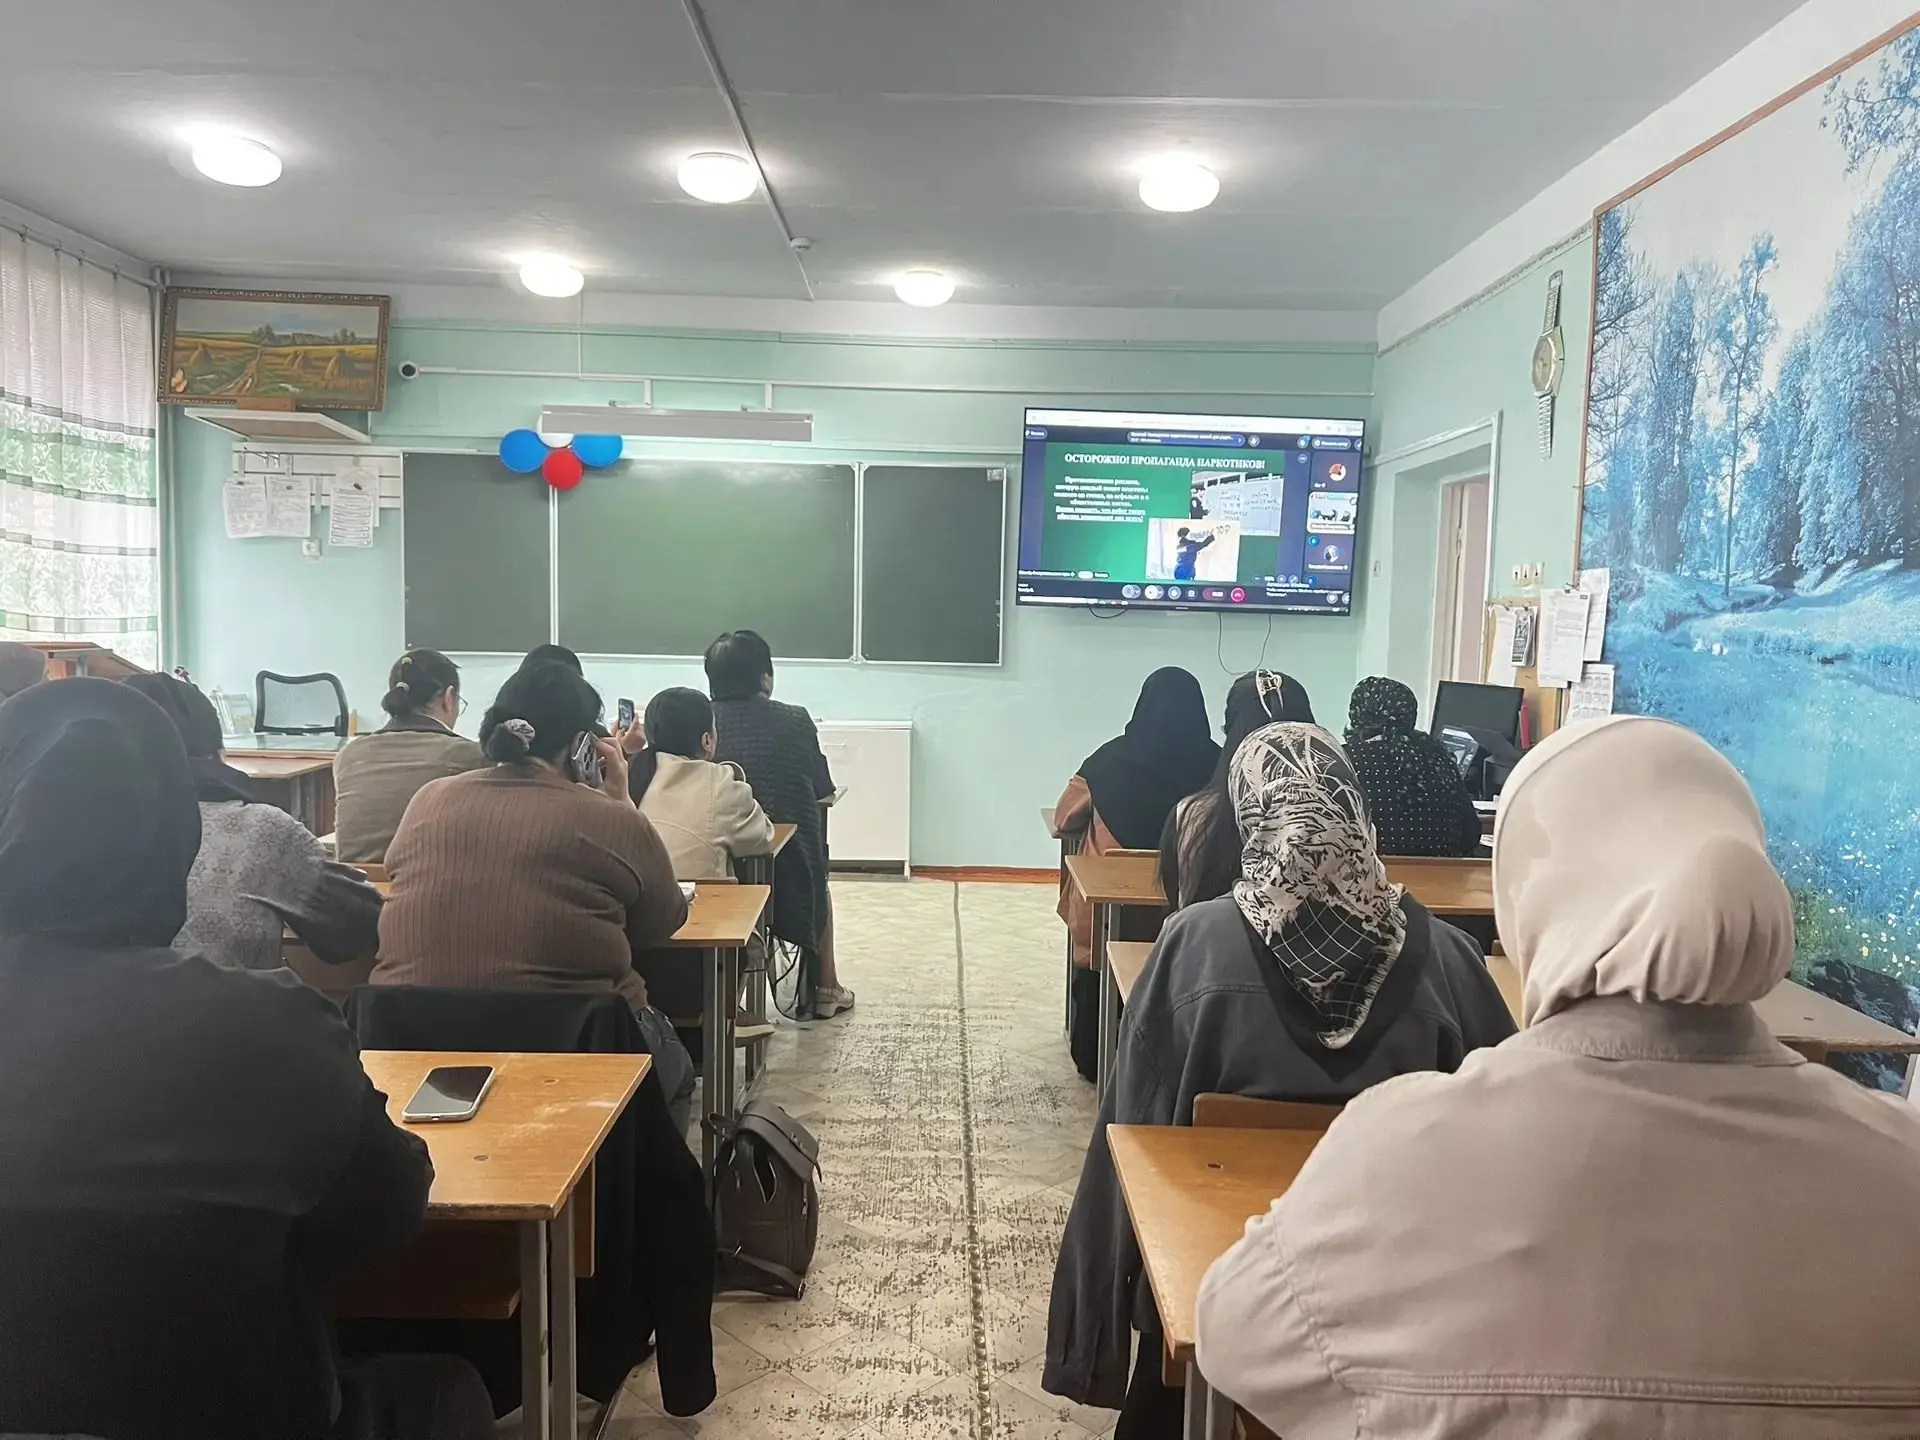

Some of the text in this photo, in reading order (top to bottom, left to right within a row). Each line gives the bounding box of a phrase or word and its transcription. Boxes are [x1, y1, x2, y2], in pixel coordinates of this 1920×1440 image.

[1064, 453, 1265, 468] ОСТОРОЖНО! ПРОПАГАНДА НАРКОТИКОВ!
